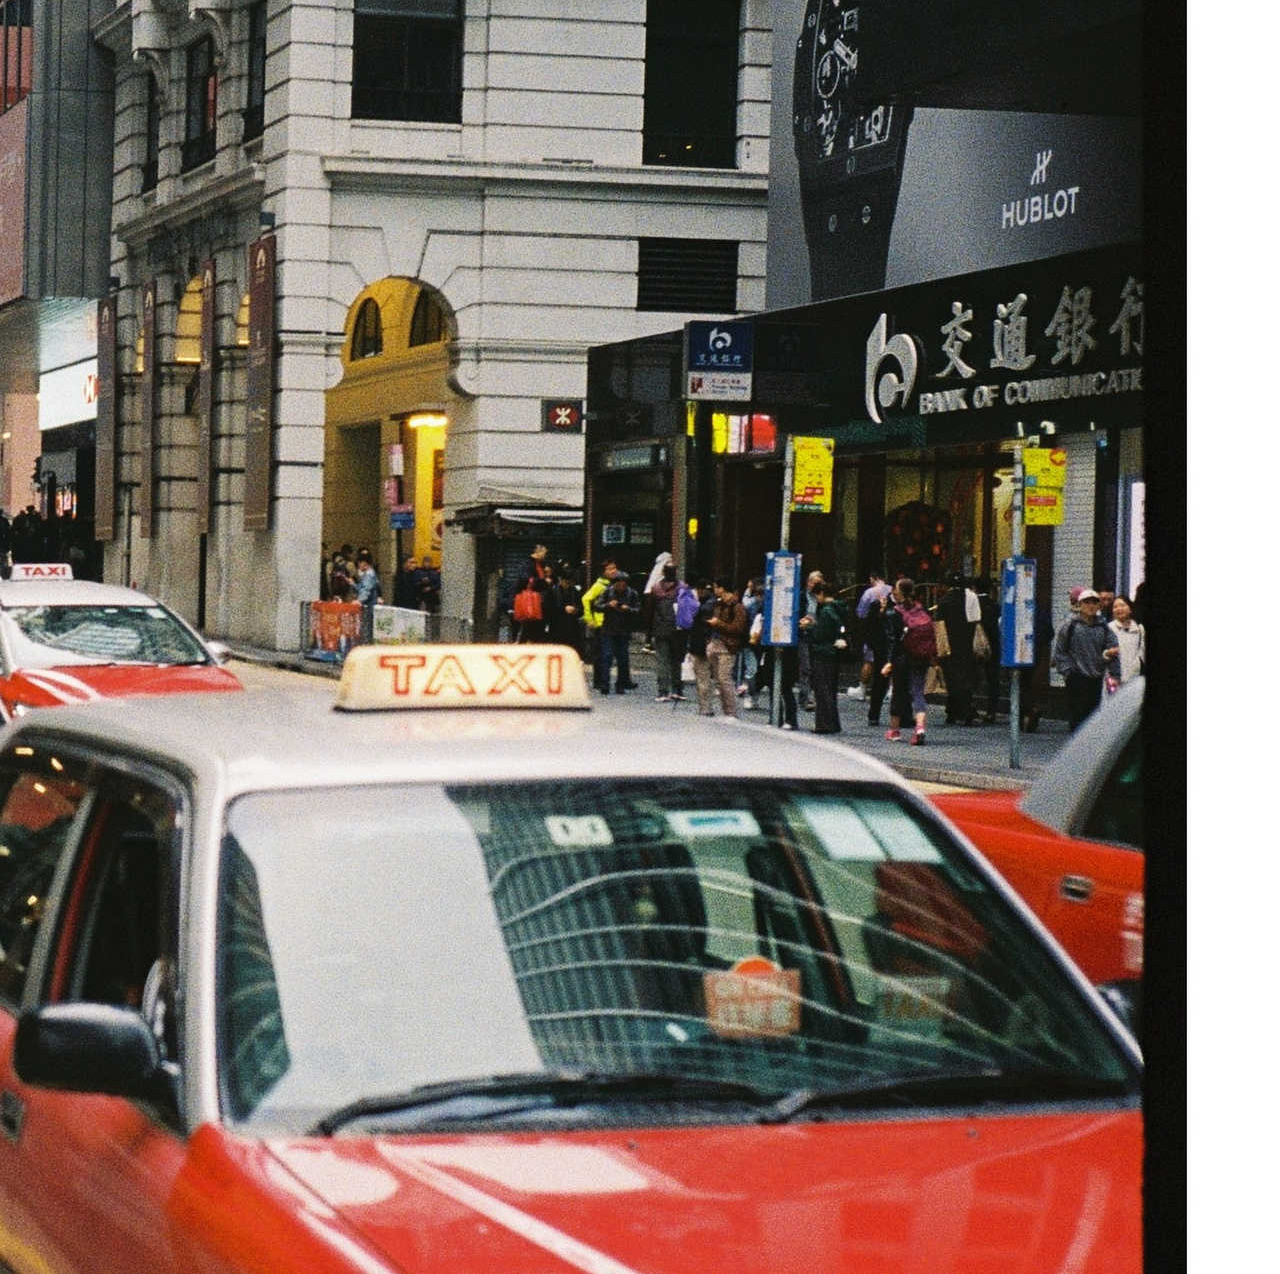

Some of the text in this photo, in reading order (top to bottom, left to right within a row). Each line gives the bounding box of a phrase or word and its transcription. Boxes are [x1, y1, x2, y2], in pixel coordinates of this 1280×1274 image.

[1002, 187, 1080, 229] HUBLOT
[919, 387, 968, 415] BANK
[973, 384, 1000, 409] OF
[21, 566, 66, 576] TAXI
[379, 654, 562, 696] TAXI
